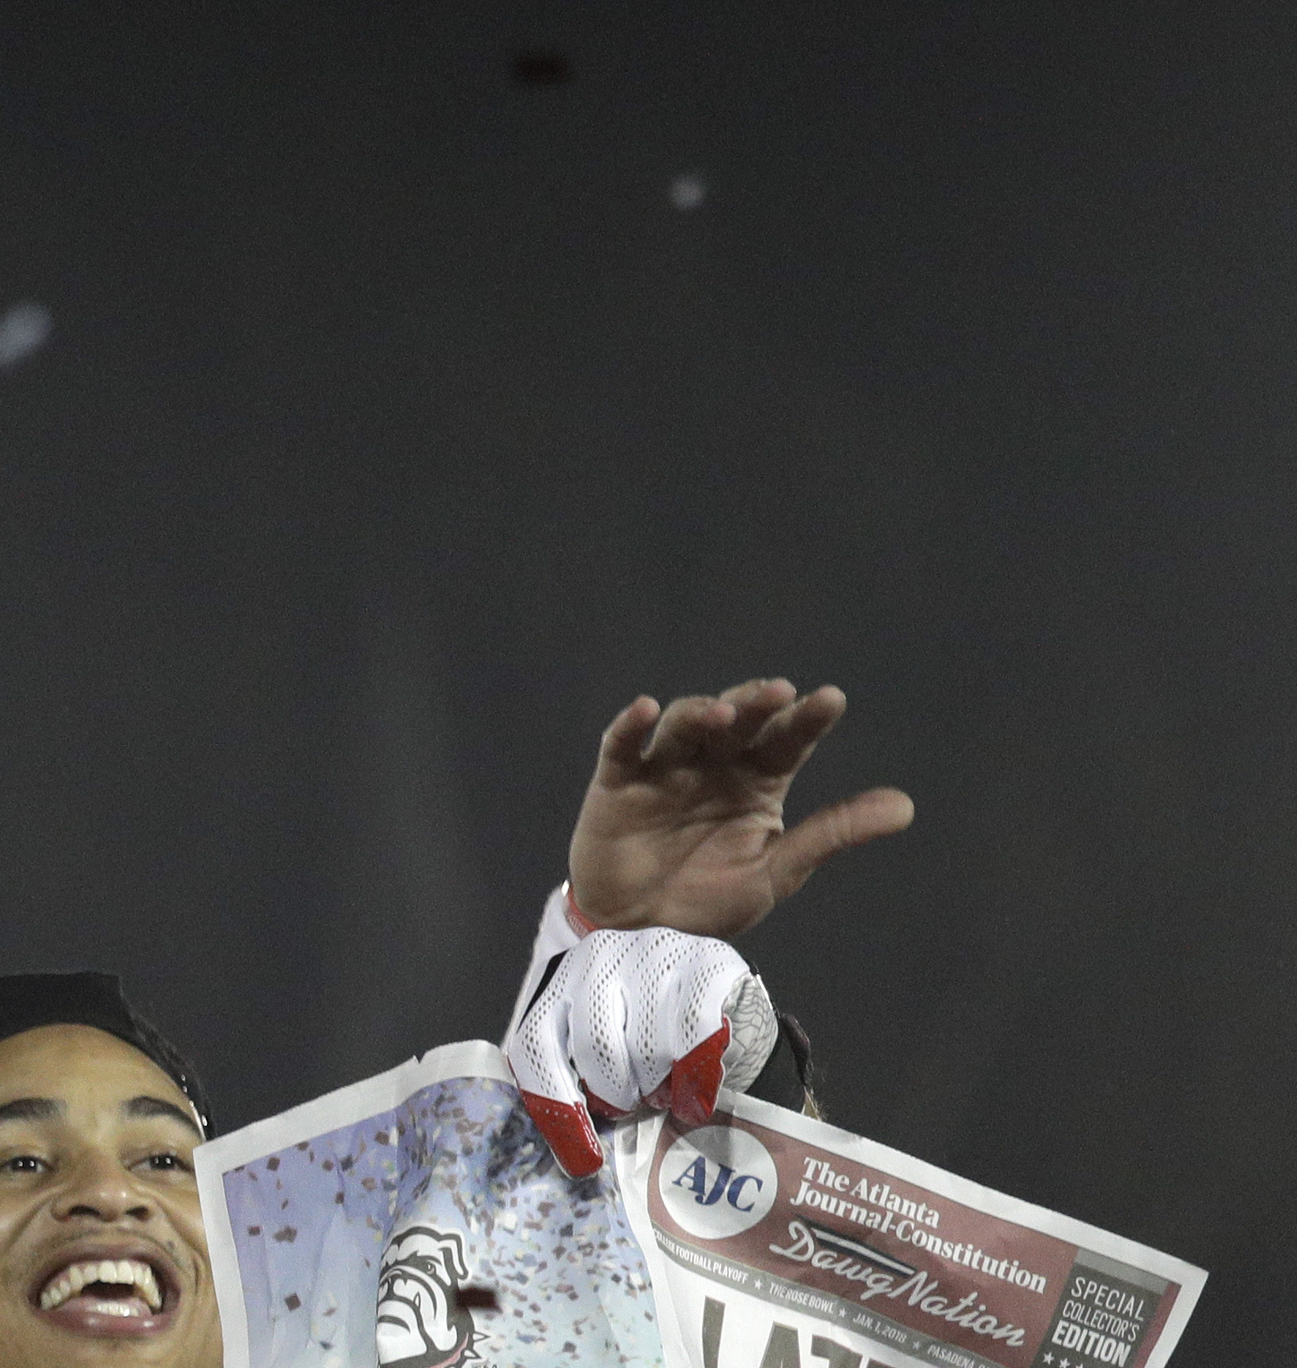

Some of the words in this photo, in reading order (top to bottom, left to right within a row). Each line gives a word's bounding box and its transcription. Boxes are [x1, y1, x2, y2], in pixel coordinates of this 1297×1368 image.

[671, 1154, 765, 1213] AJC
[802, 1156, 850, 1191] The
[850, 1170, 941, 1230] Atlanta
[790, 1180, 1049, 1295] Journal-Constitution
[676, 1244, 713, 1271] FOOTBALL
[713, 1262, 750, 1285] PLAYOFF
[769, 1282, 786, 1298] THE
[785, 1286, 809, 1306] ROSE
[808, 1293, 835, 1314] BOWL
[852, 1312, 873, 1329] JAN.
[881, 1326, 908, 1344] 2018
[1062, 1300, 1140, 1343] COLLECTOR'S
[1070, 1276, 1145, 1321] SPECIAL
[1051, 1319, 1132, 1368] EDITION
